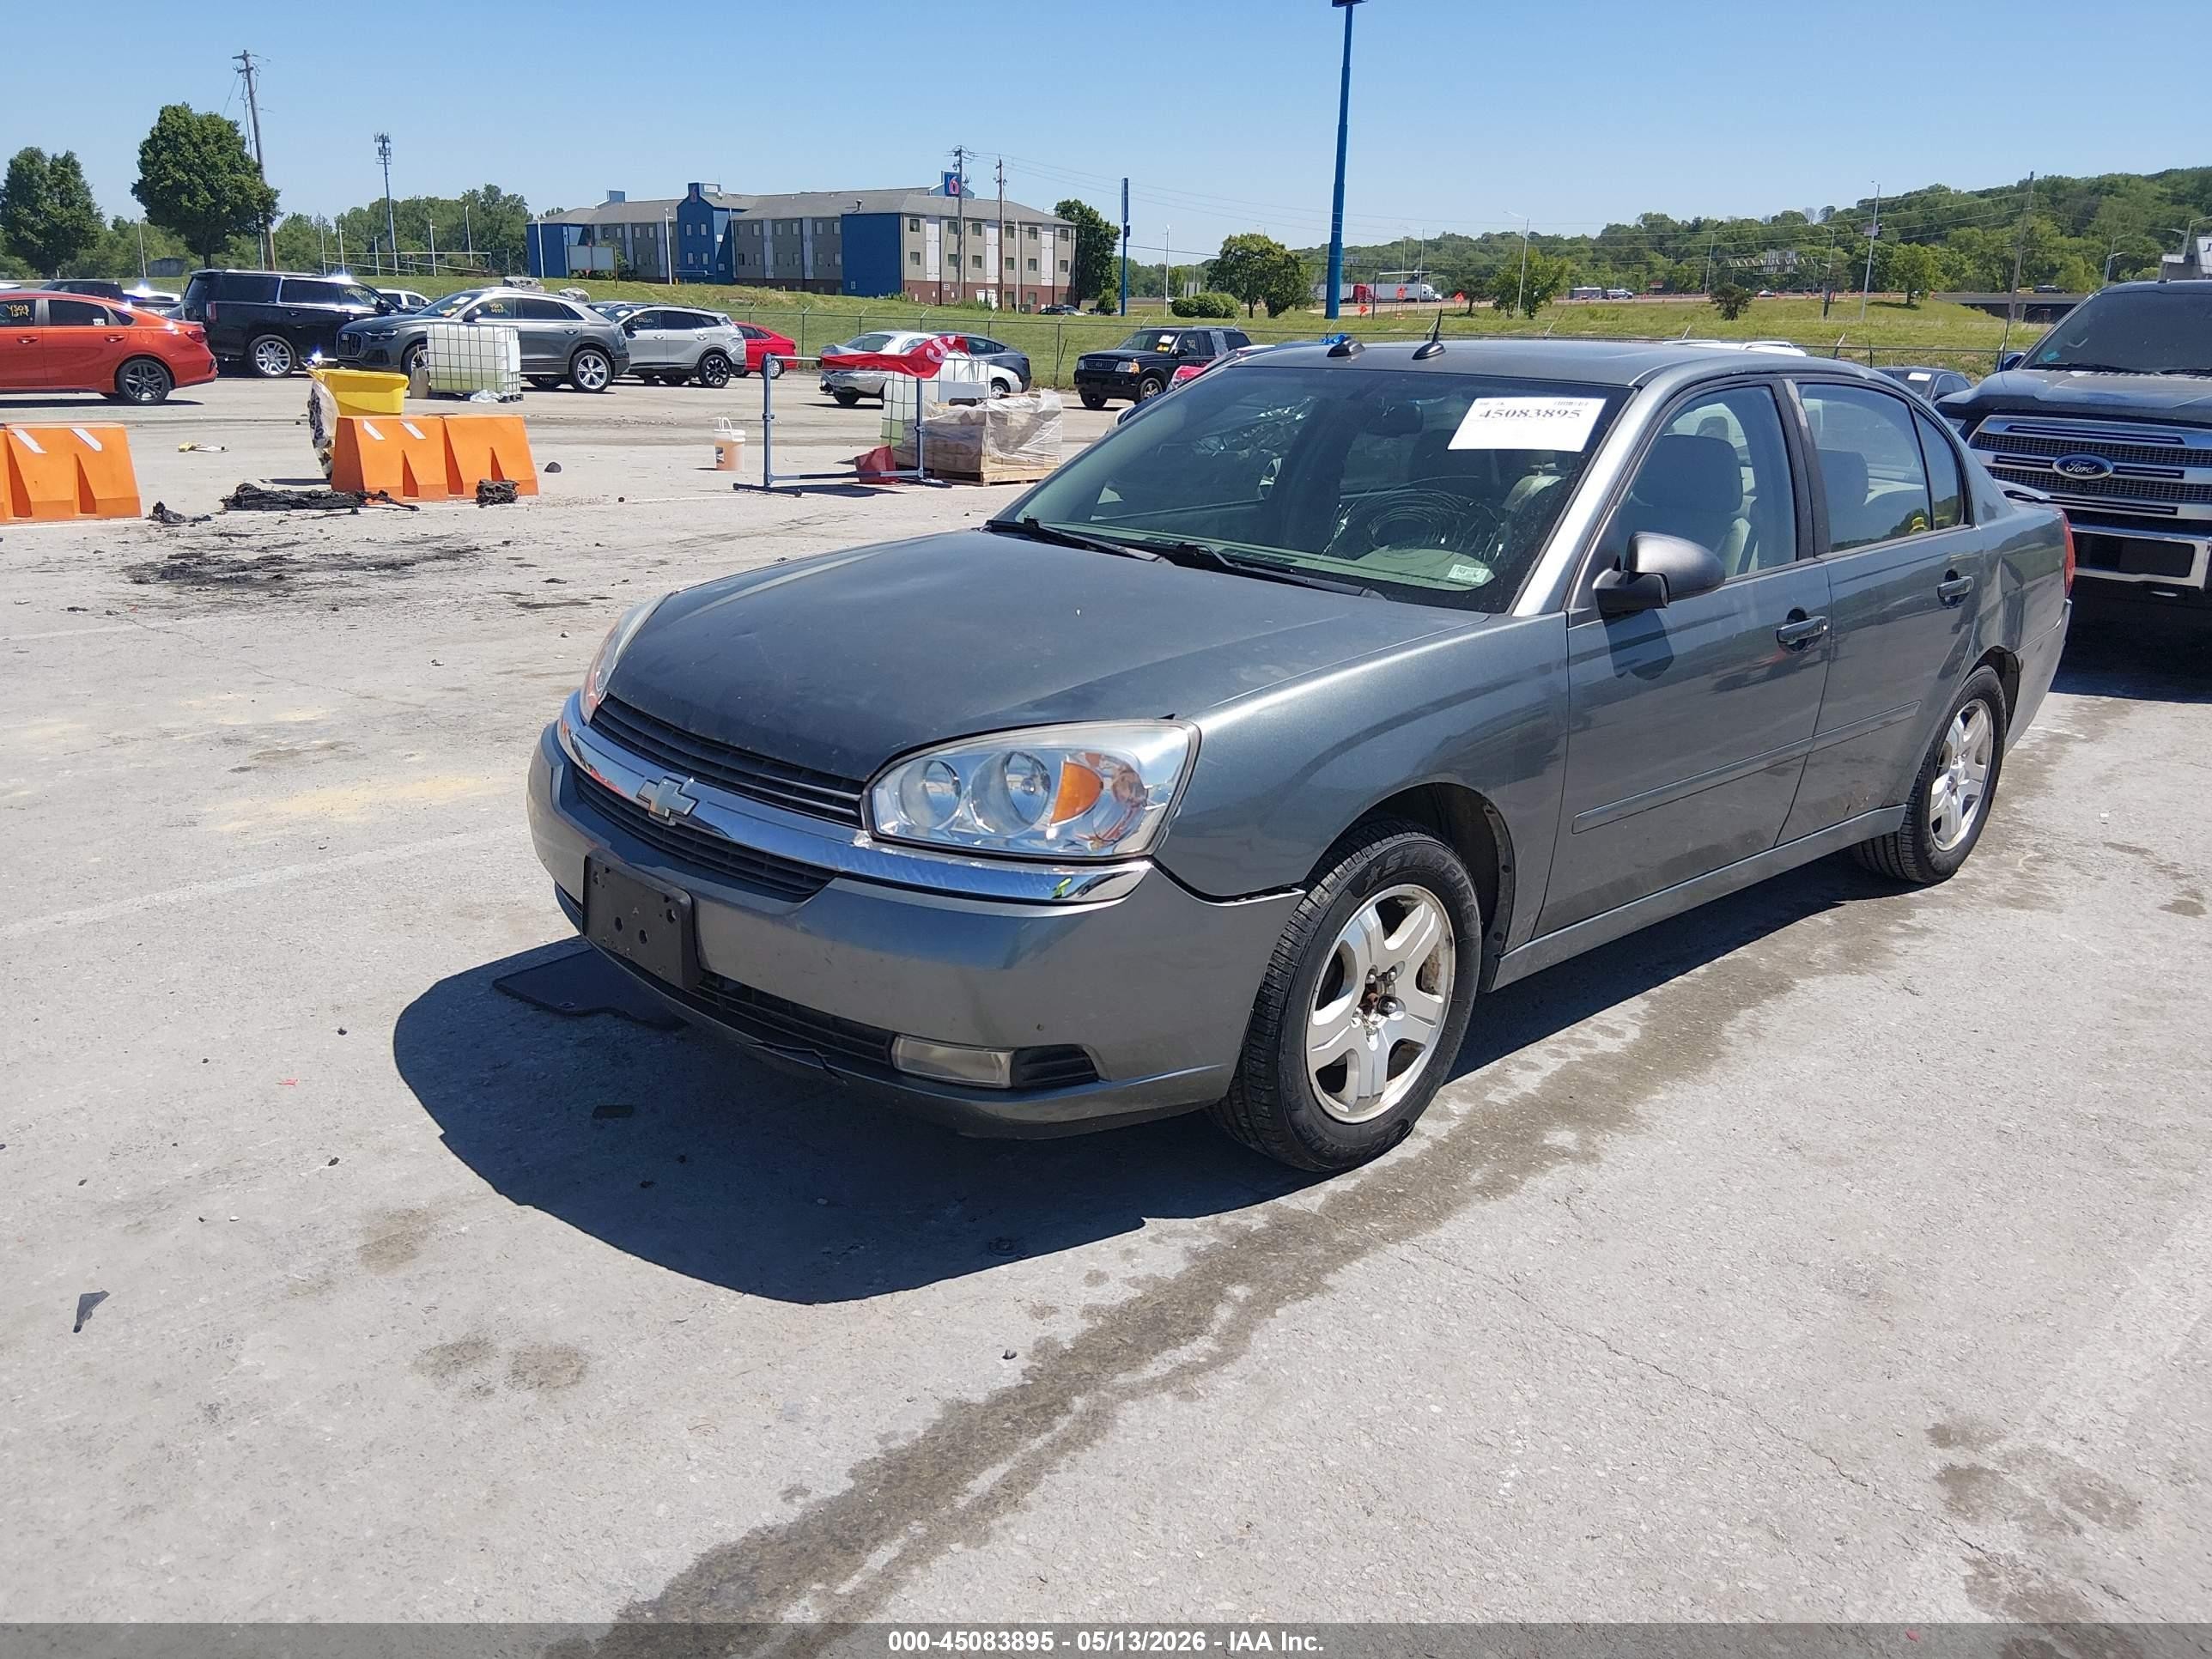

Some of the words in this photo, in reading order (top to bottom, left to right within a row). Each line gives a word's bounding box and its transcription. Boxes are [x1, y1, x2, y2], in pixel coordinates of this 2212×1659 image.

[949, 175, 959, 195] 6
[1479, 409, 1582, 418] 45083895
[2066, 460, 2096, 473] Ford
